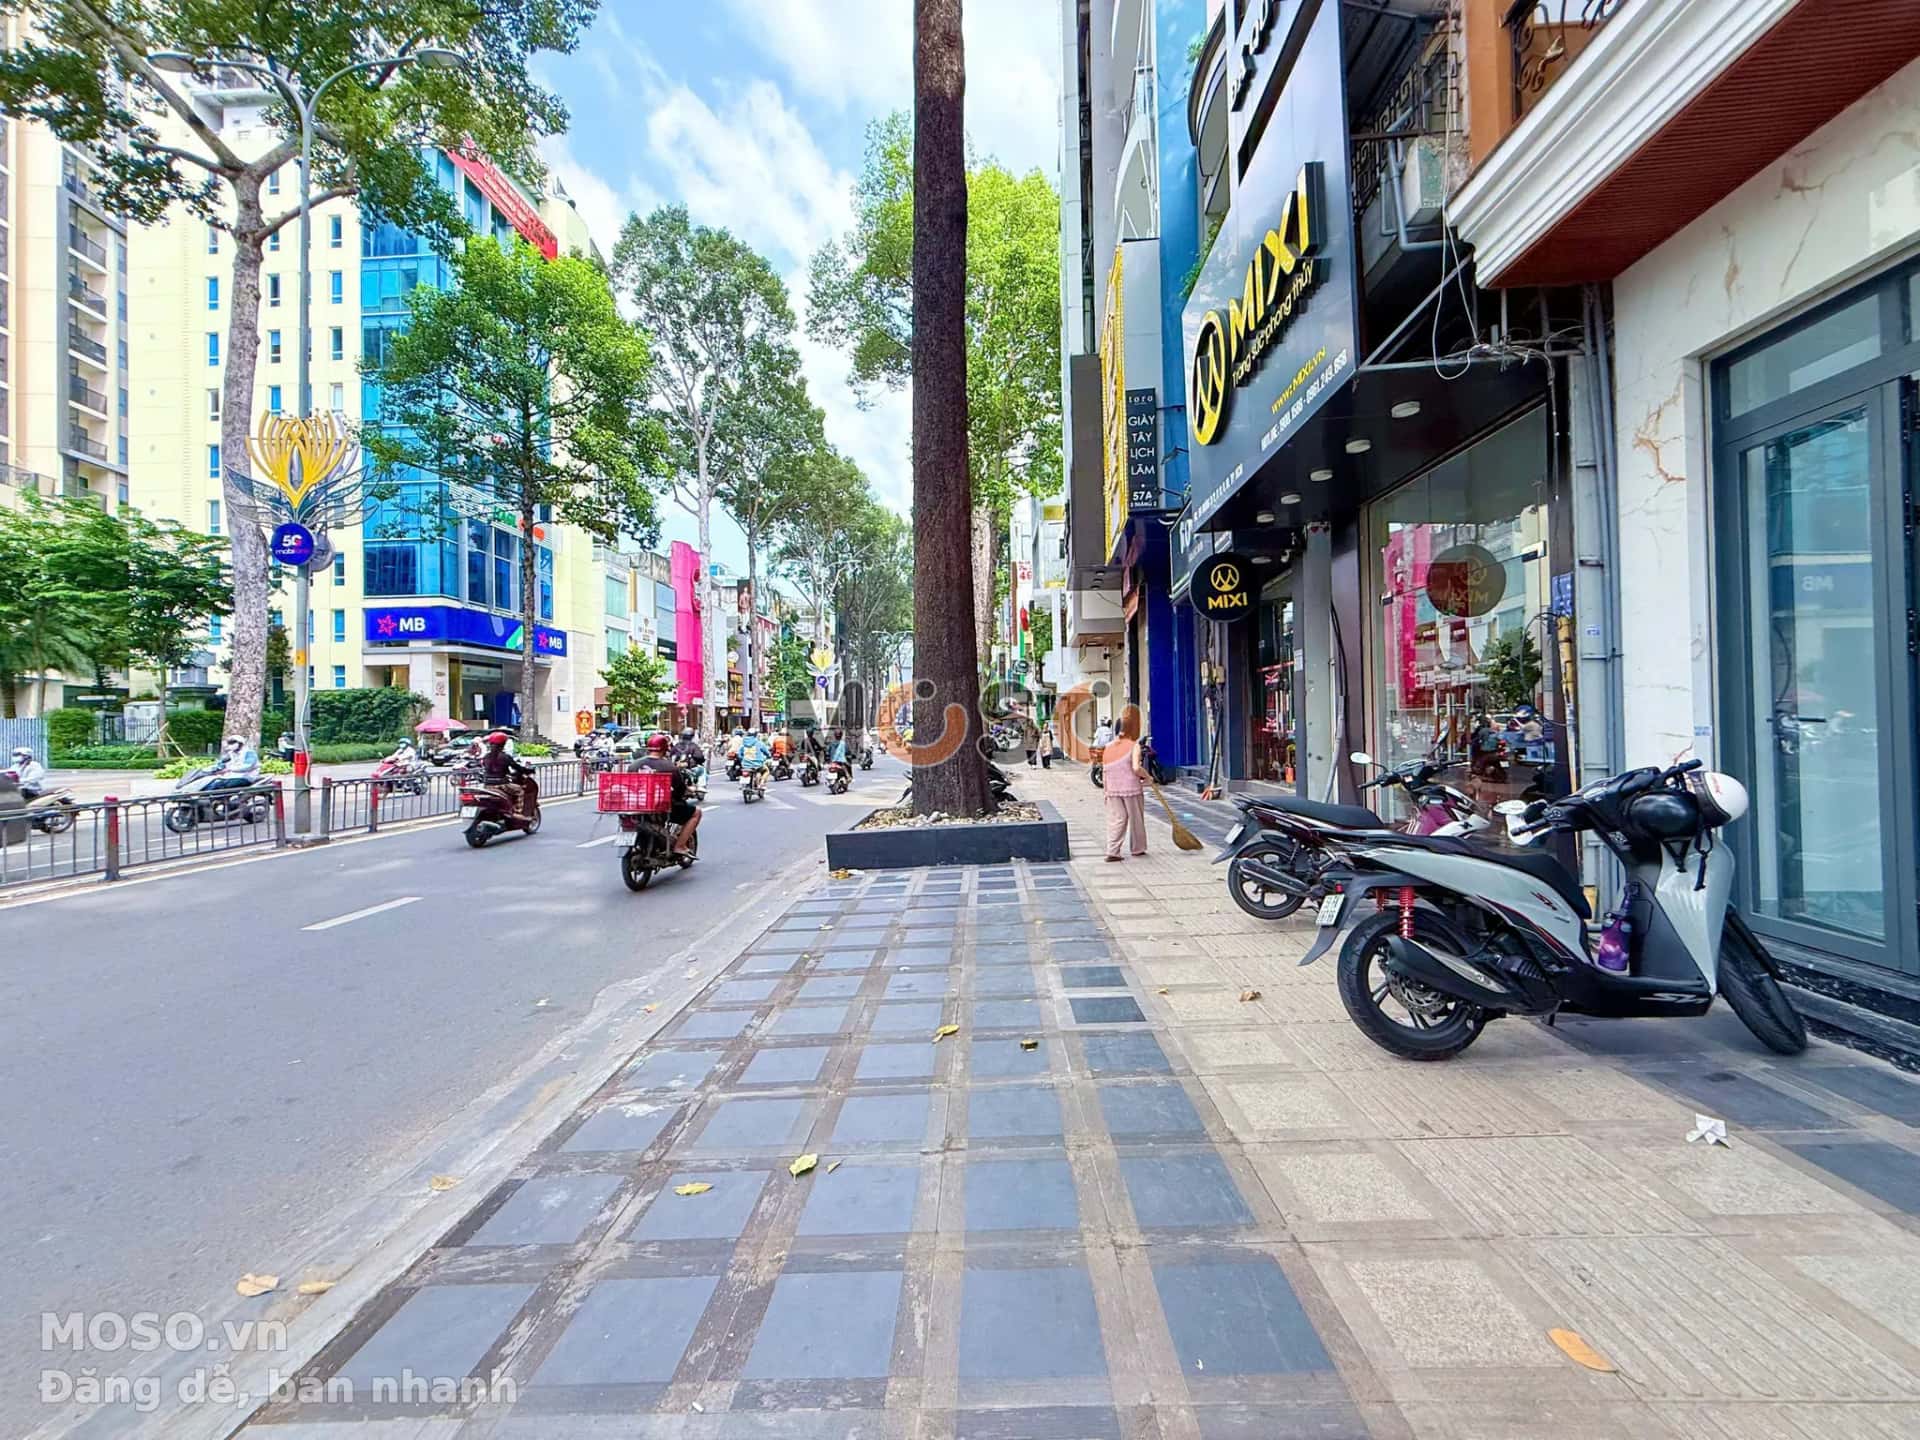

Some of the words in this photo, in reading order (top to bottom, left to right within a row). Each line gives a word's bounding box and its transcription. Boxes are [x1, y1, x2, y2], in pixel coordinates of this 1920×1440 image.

[1229, 162, 1312, 363] MIXI
[1265, 294, 1292, 344] phong
[1128, 414, 1155, 426] GIÀY
[1130, 448, 1155, 459] LỊCH
[1131, 464, 1155, 475] LÃM
[1133, 491, 1152, 501] 57A
[282, 534, 302, 547] 5G
[1207, 591, 1248, 610] MIXI
[399, 617, 426, 632] MB
[549, 636, 563, 649] MB
